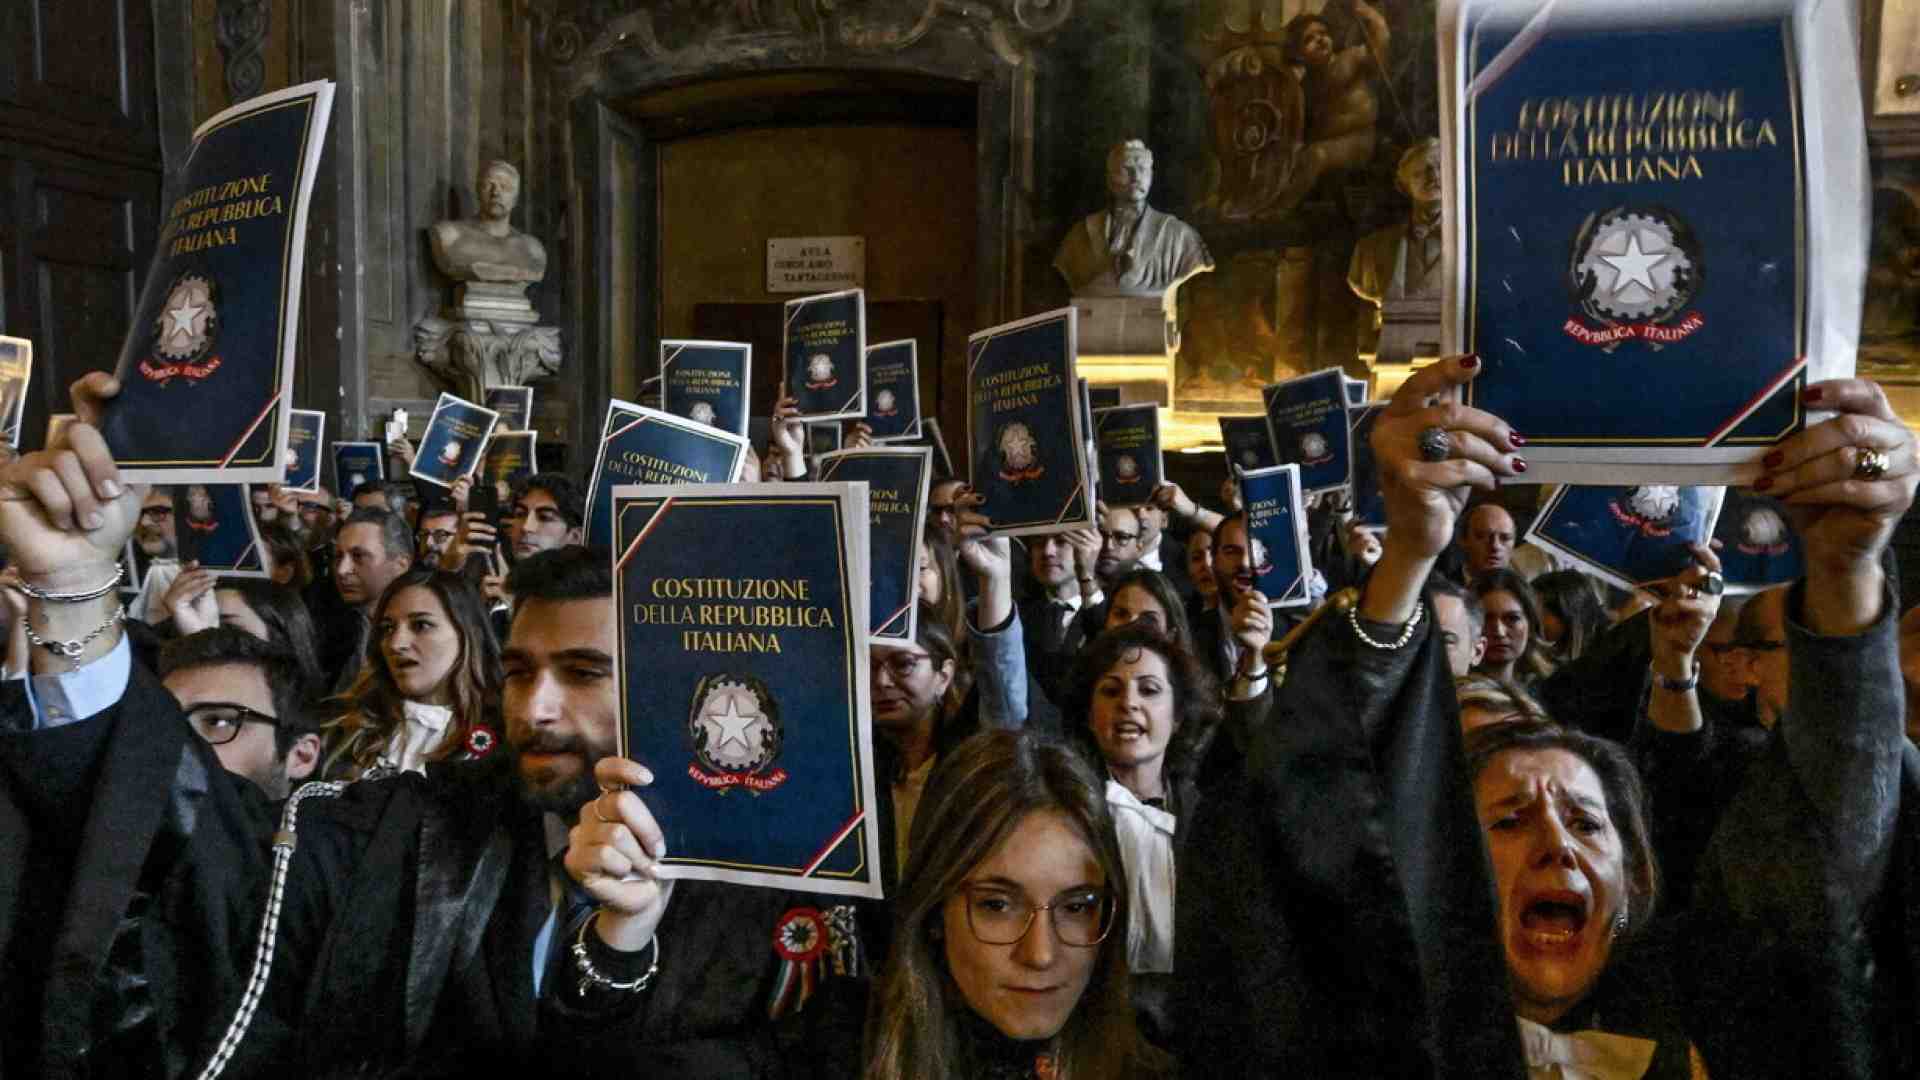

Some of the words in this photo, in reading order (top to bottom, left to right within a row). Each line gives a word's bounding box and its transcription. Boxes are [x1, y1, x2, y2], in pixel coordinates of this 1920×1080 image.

[1489, 128, 1578, 160] DELLA
[1587, 118, 1777, 156] REPUBBLICA
[1563, 155, 1704, 185] ITALIANA
[652, 578, 811, 600] COSTITUZIONE
[633, 603, 695, 624] DELLA
[700, 605, 834, 628] REPUBBLICA
[682, 631, 782, 653] ITALIANA
